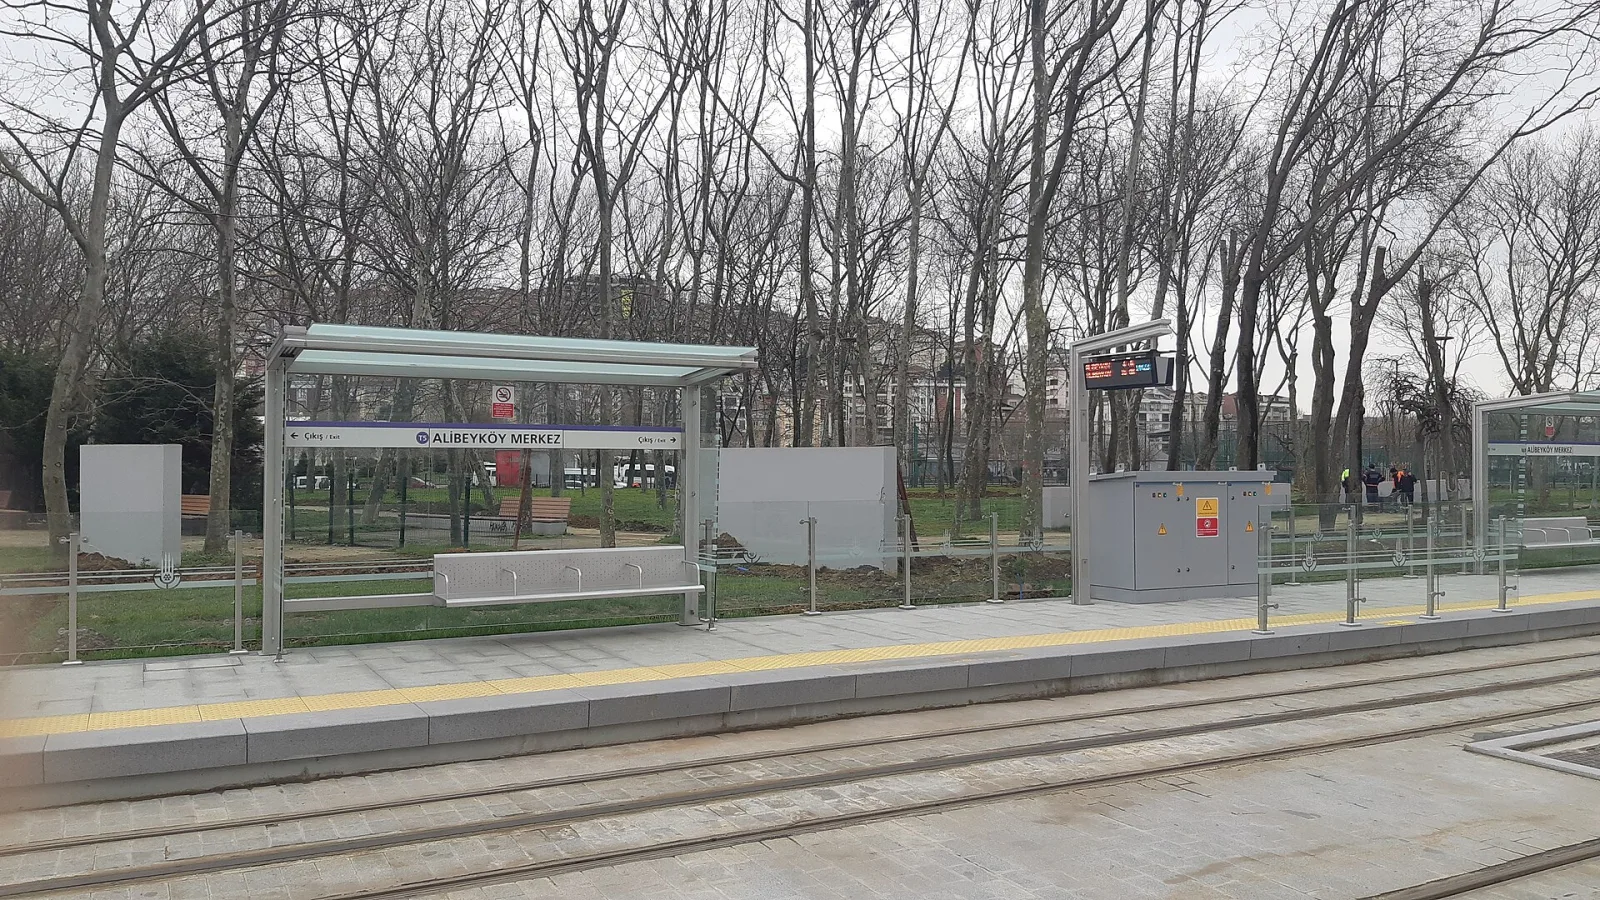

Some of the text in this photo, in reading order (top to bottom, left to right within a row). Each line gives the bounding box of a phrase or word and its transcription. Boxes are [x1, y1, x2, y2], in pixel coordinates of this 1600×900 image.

[304, 432, 324, 441] Çıkış
[432, 430, 561, 445] ALİBEYKÖY MERKEZ
[638, 436, 653, 445] Çıkış
[1554, 446, 1573, 454] MERKEZ
